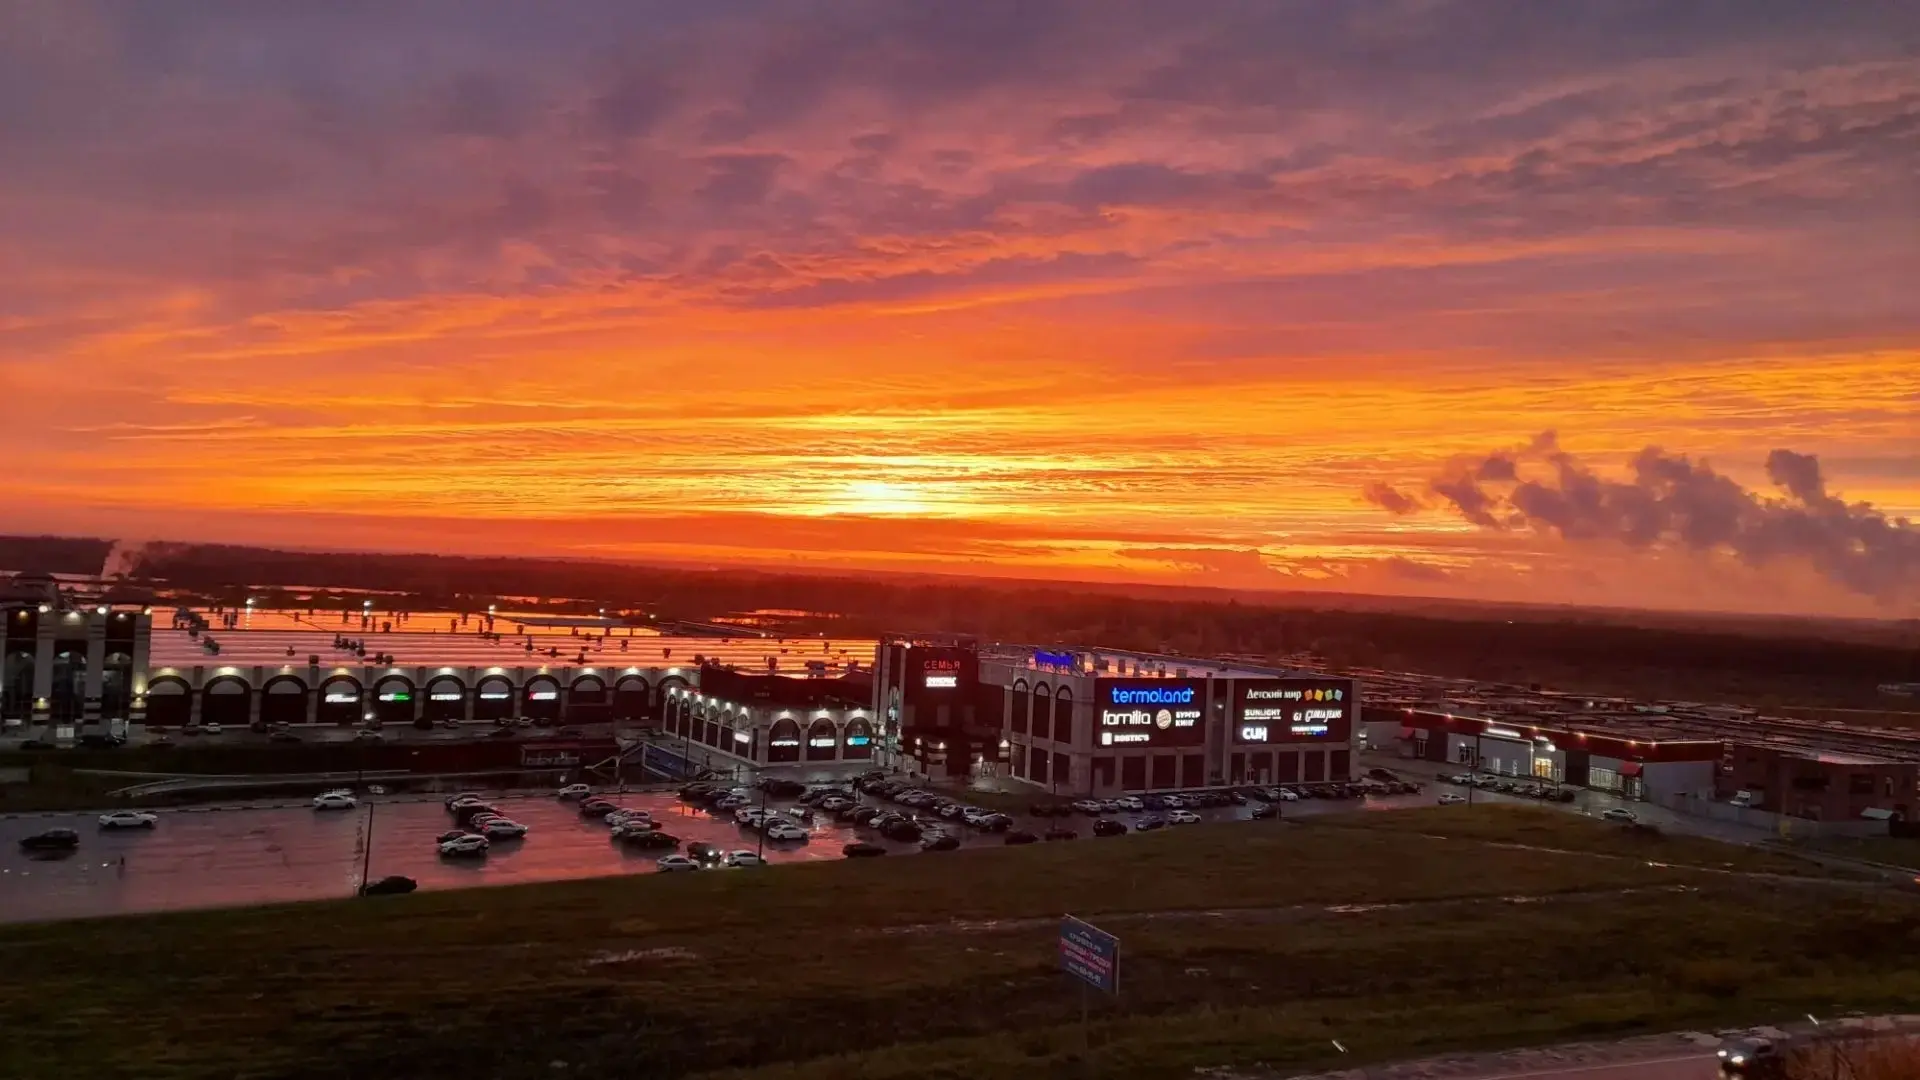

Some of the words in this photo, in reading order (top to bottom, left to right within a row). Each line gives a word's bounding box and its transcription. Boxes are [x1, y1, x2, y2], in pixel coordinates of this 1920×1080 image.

[924, 660, 960, 670] СЕМЬЯ
[1112, 687, 1191, 703] termoland
[1246, 688, 1282, 699] Детский
[1284, 690, 1302, 702] мир
[1102, 709, 1151, 725] familia
[1244, 708, 1282, 716] SUNLIGHT
